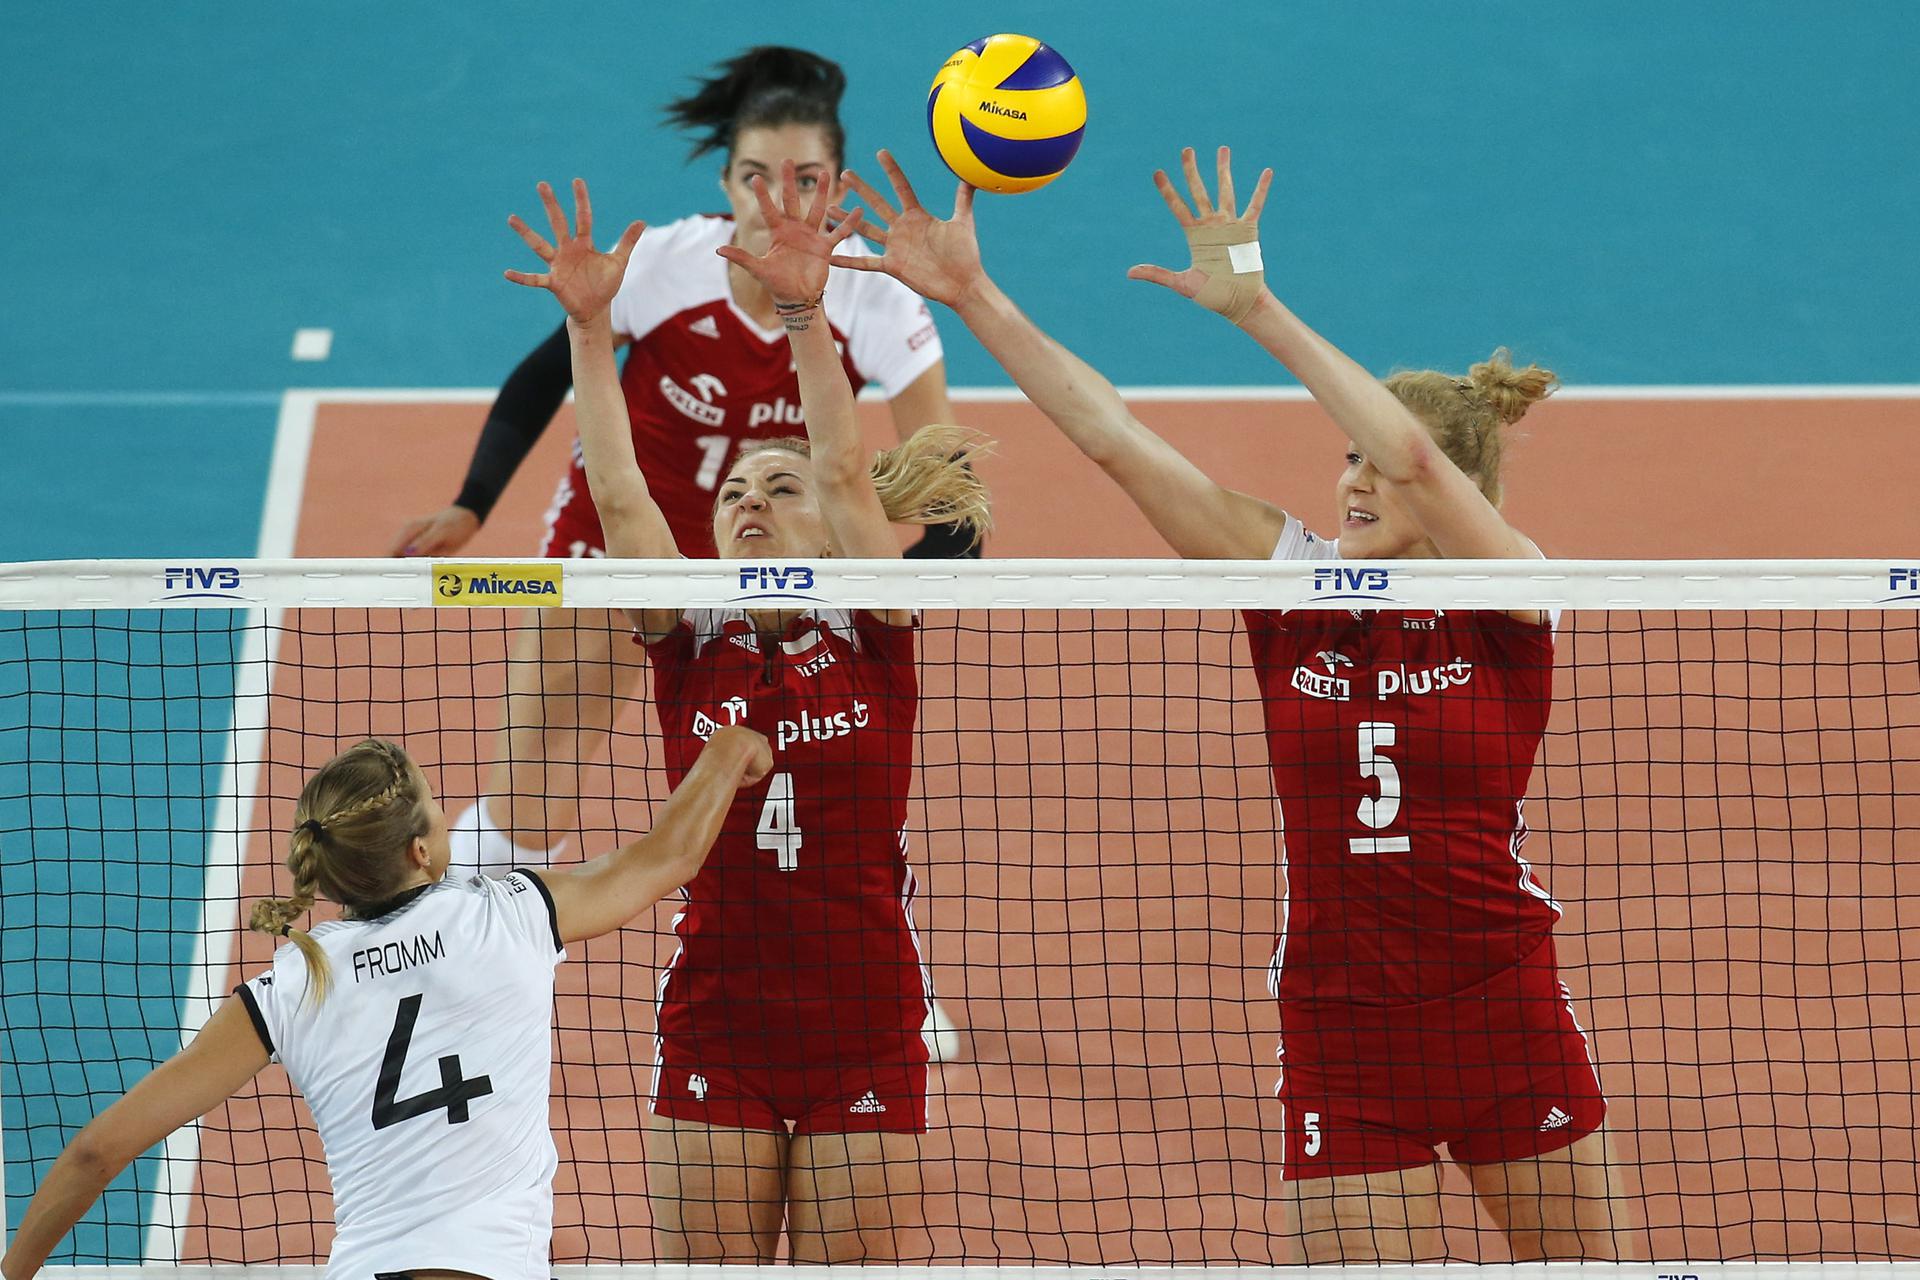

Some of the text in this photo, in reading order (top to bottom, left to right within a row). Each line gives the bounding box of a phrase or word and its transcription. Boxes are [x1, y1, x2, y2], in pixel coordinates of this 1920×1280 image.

[748, 398, 805, 428] plu
[165, 567, 240, 590] FIVB
[739, 567, 814, 590] FIVB
[1313, 568, 1389, 590] FIVB
[1889, 568, 1920, 590] FI
[1295, 669, 1346, 698] ORLEN
[1356, 721, 1402, 830] 5
[756, 773, 803, 872] 4
[352, 930, 446, 984] FROMM
[371, 992, 494, 1131] 4
[687, 1073, 708, 1102] 4
[849, 1103, 887, 1114] adidas
[1304, 1112, 1322, 1158] 5
